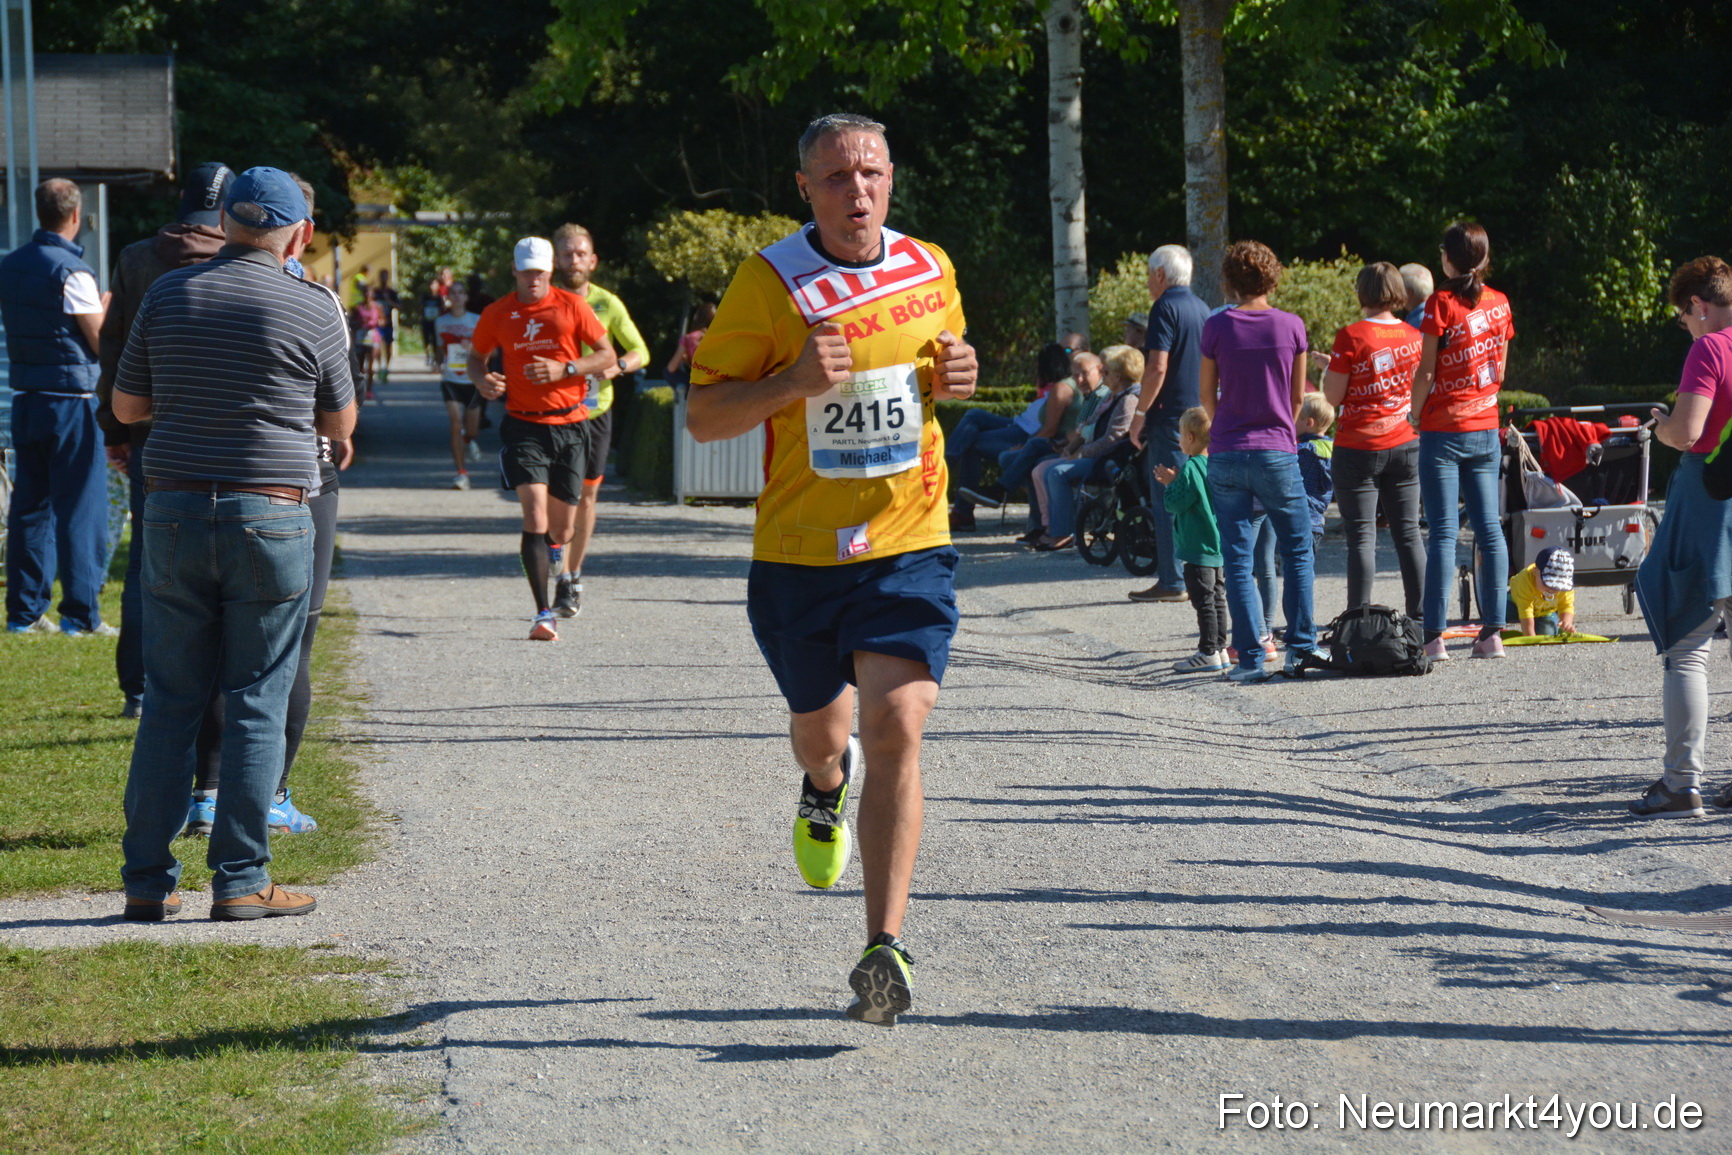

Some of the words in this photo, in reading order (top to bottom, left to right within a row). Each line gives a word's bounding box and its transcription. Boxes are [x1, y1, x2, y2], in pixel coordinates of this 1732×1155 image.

[828, 312, 886, 345] AX
[889, 290, 946, 327] BÖGL
[1373, 326, 1407, 339] Team
[840, 378, 887, 394] BOCK
[824, 397, 905, 434] 2415
[858, 435, 890, 445] Neumarkt
[840, 448, 892, 466] Michael
